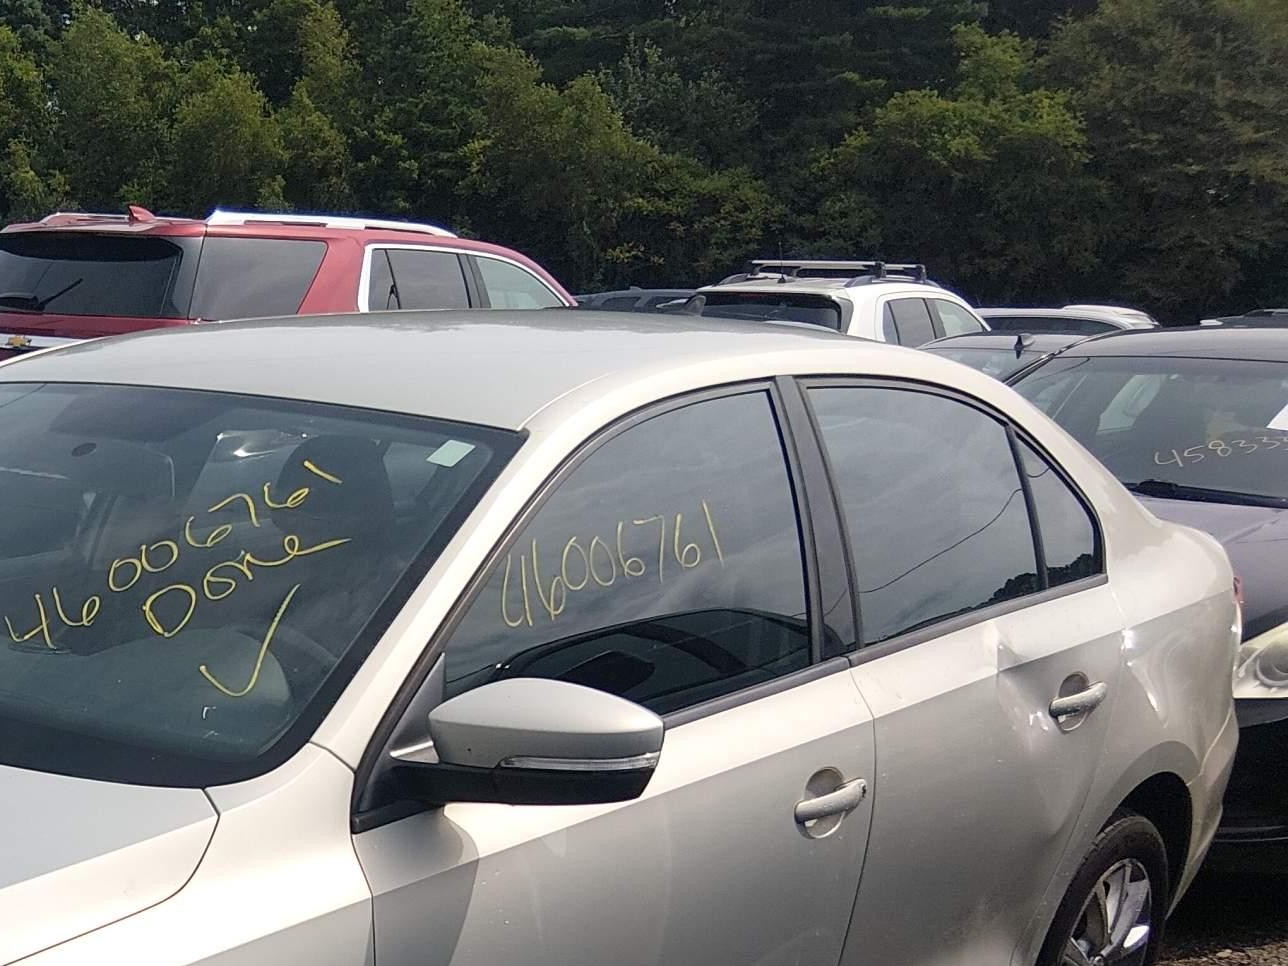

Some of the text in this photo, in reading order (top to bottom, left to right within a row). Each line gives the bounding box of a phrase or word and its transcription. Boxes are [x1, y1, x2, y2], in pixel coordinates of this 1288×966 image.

[4, 459, 343, 651] 46006761
[142, 534, 352, 638] Done
[501, 499, 726, 628] 46006761
